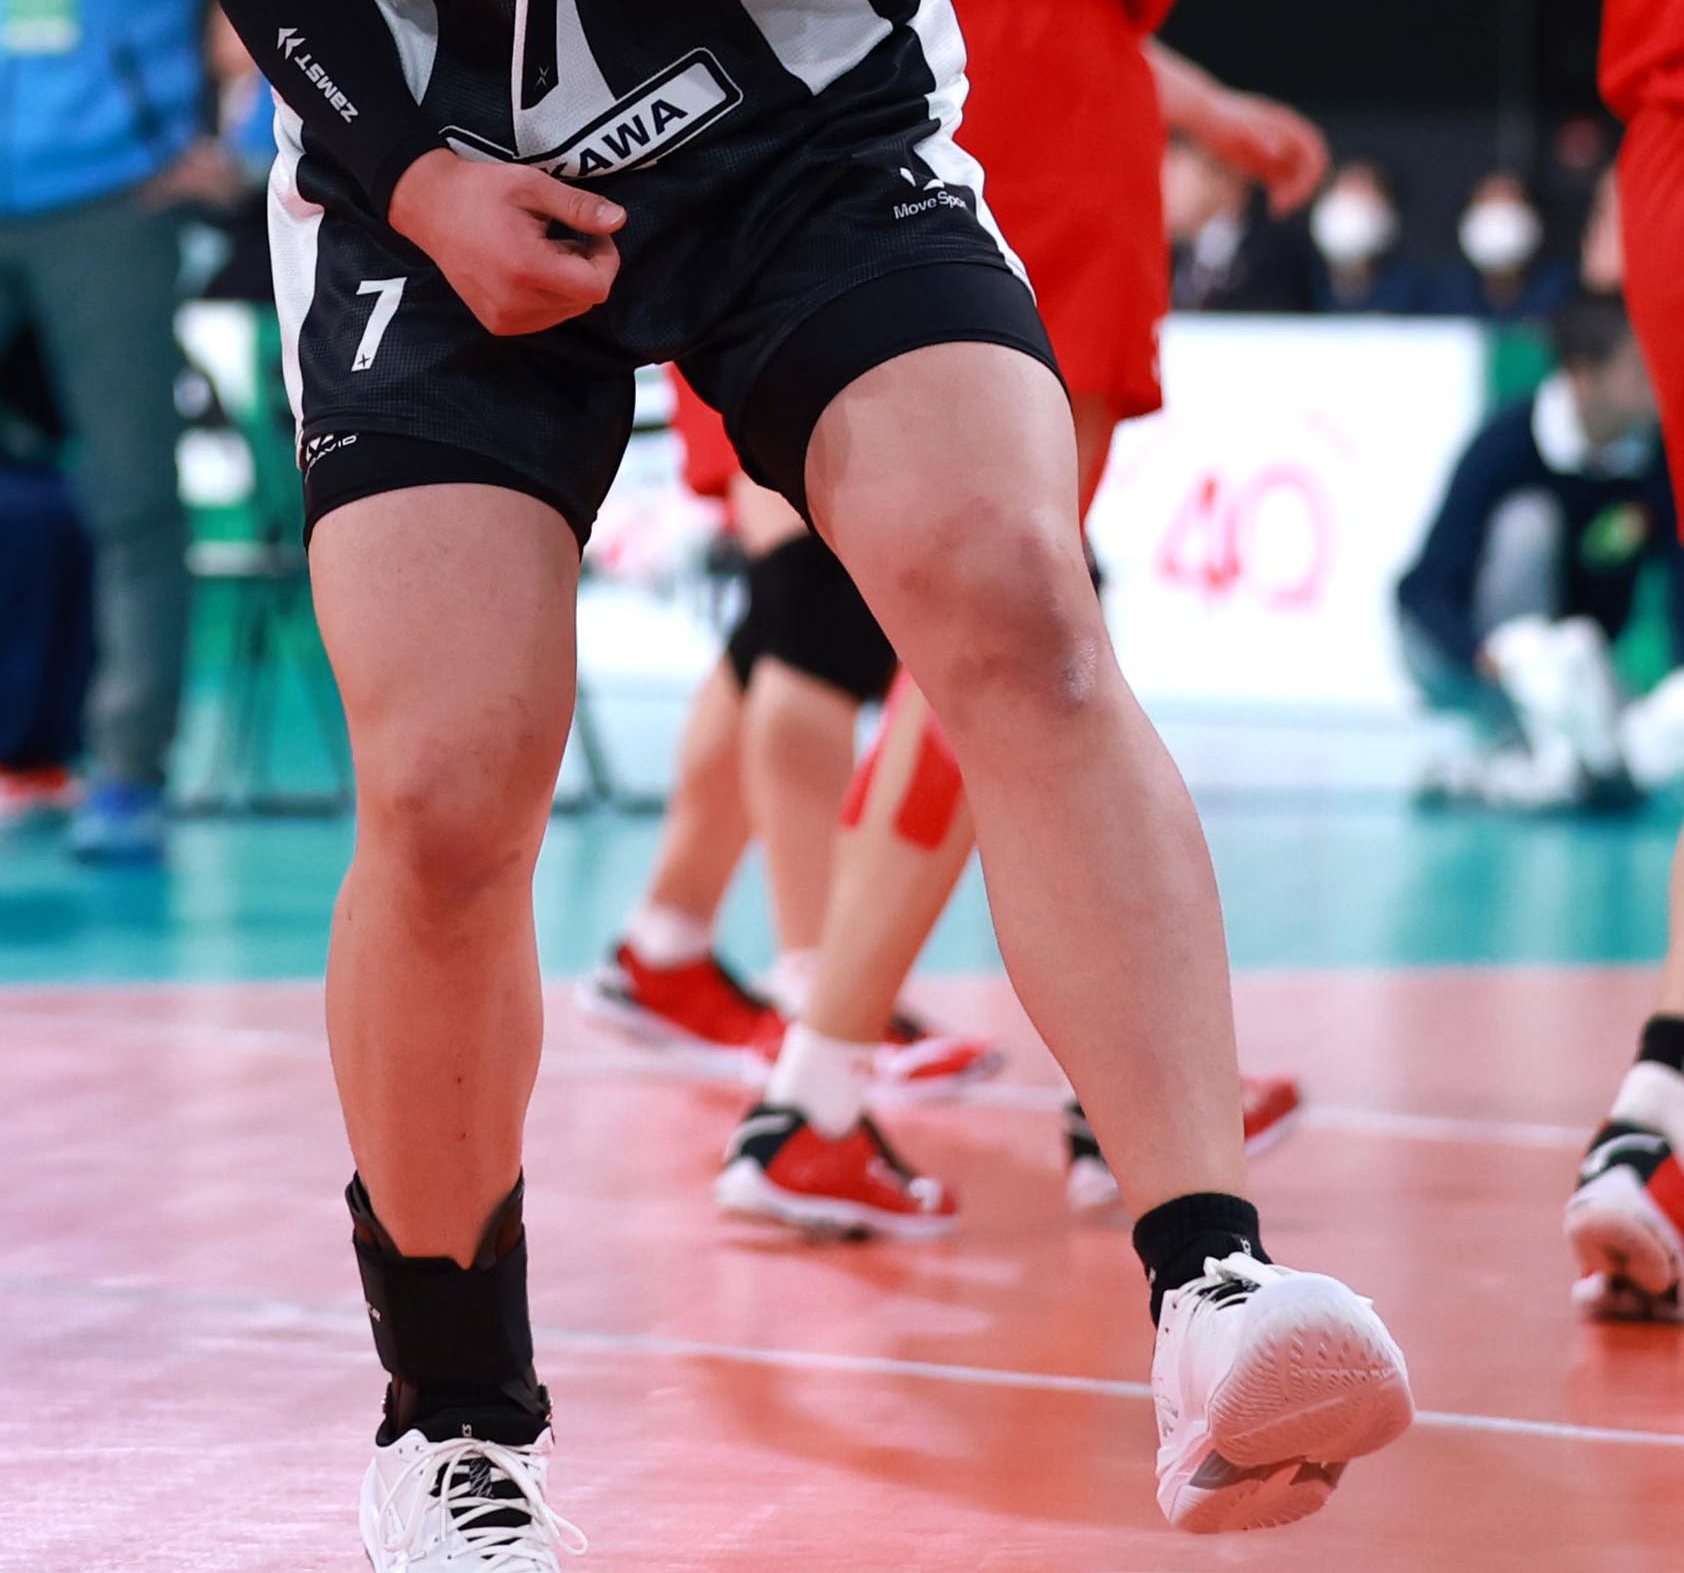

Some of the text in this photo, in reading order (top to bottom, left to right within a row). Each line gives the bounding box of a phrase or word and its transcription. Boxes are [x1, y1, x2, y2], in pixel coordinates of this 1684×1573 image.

[540, 97, 689, 177] KAWA
[892, 197, 937, 220] Move
[350, 277, 408, 372] 7
